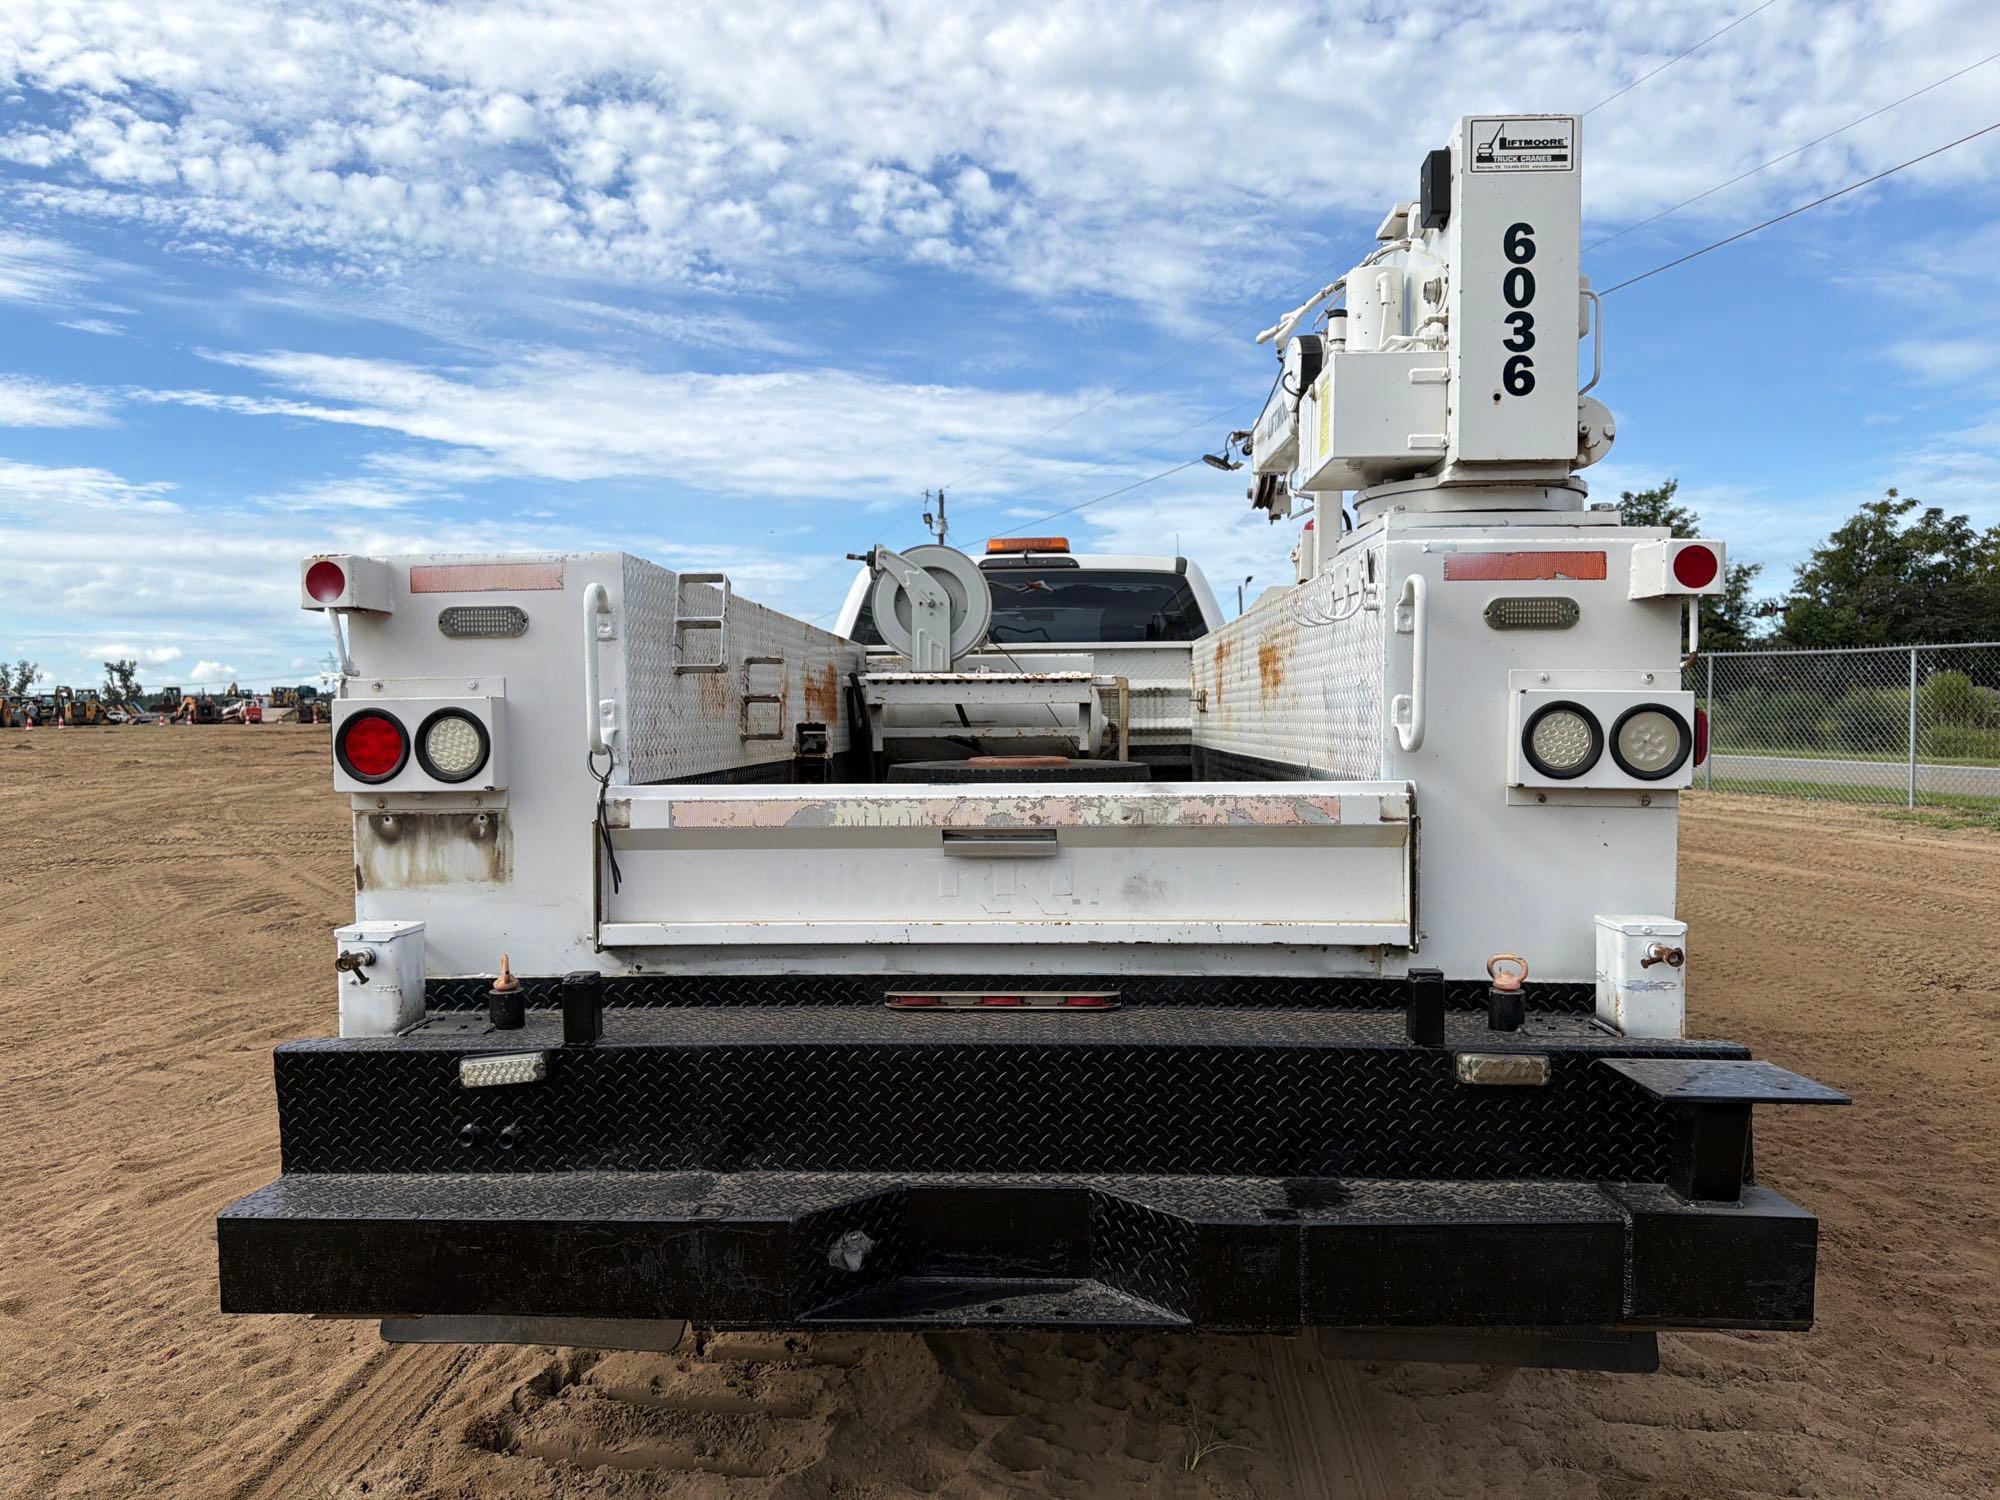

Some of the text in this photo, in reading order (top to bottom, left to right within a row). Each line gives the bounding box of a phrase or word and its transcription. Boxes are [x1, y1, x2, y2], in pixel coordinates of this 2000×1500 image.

[1499, 137, 1567, 150] LIFTMOORE
[1493, 154, 1552, 163] TRUCK CRANES
[1503, 222, 1535, 397] 6036
